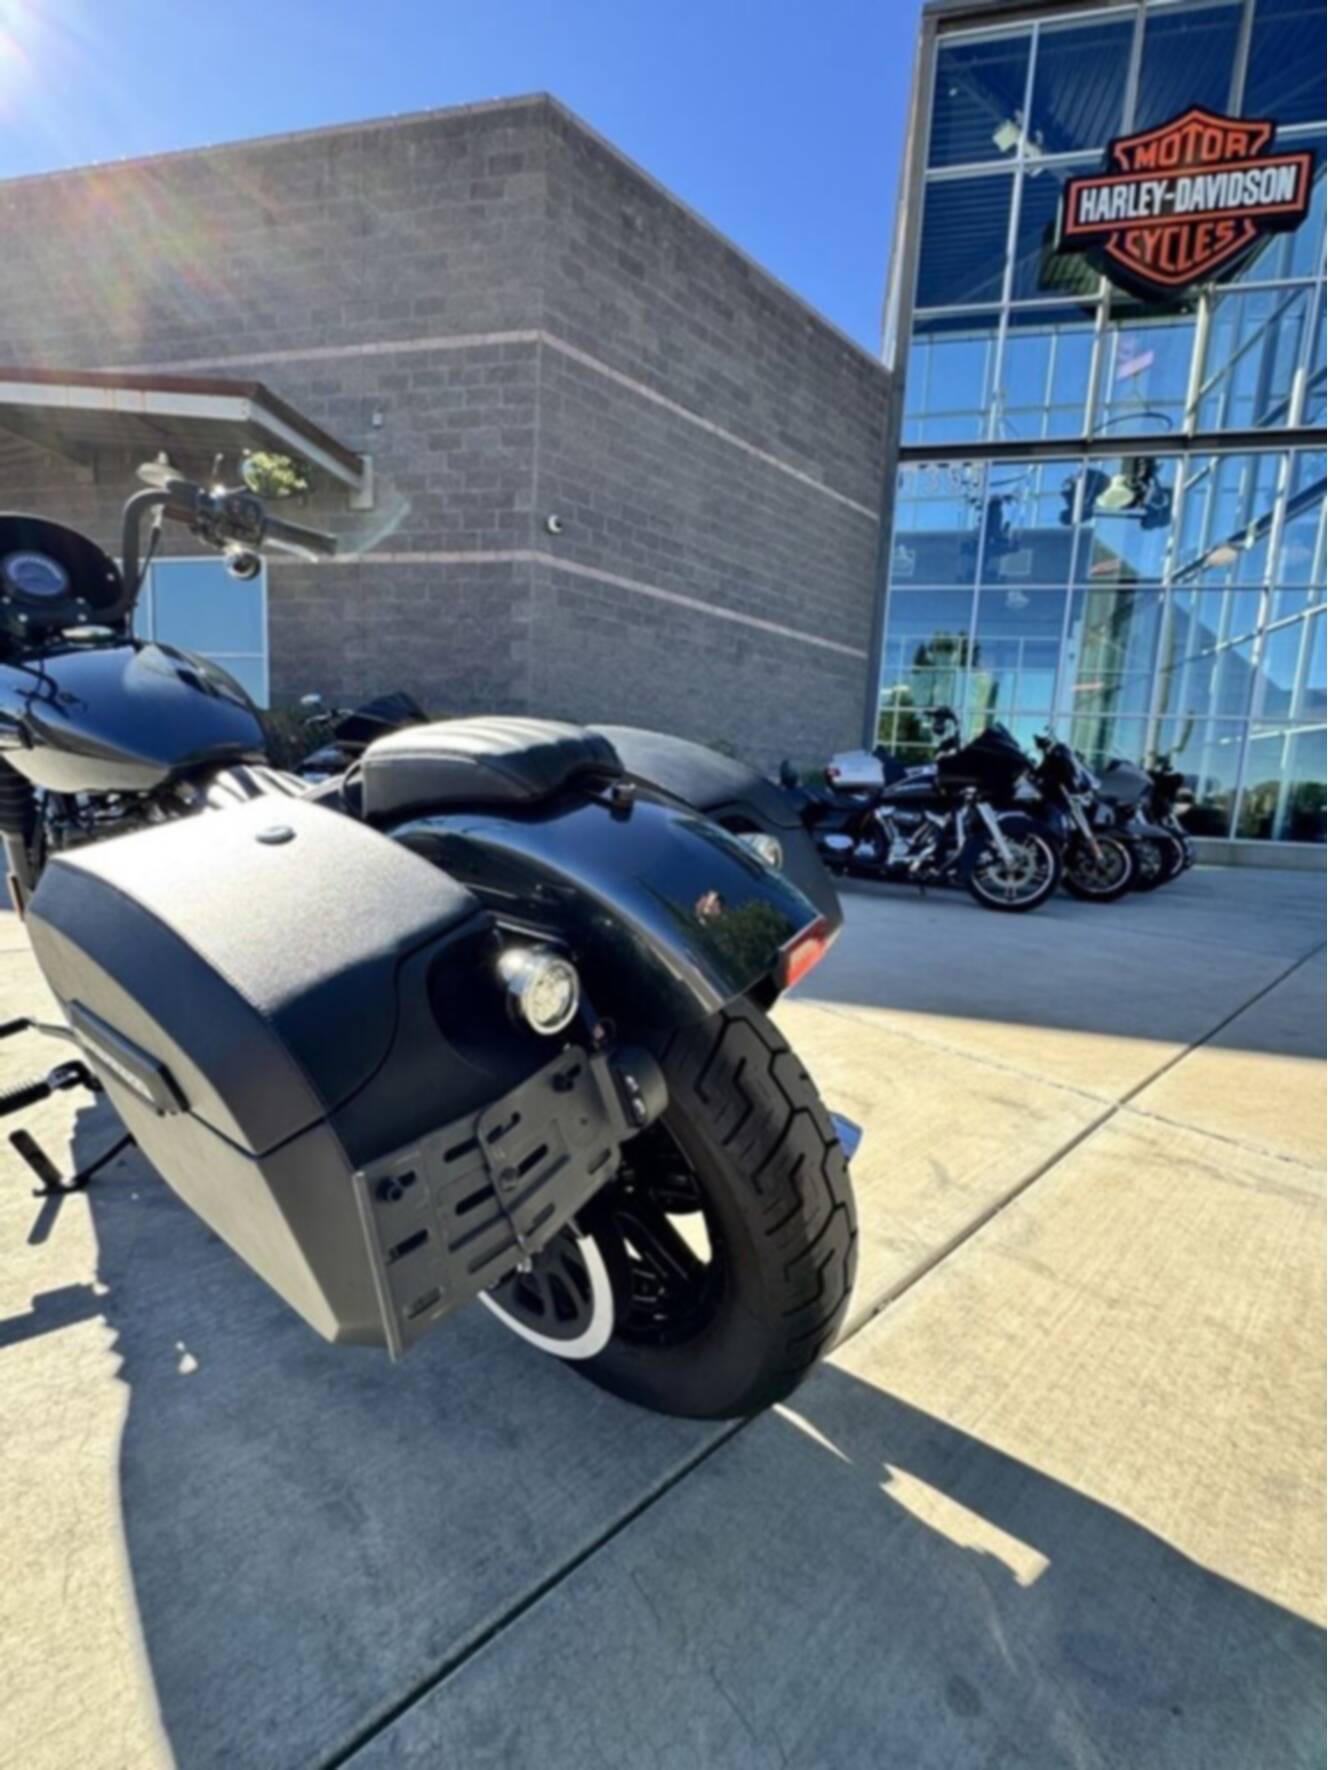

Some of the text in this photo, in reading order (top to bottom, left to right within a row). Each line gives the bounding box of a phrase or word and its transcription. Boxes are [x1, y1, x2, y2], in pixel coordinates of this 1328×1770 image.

[1133, 124, 1248, 170] MOTOR
[1078, 165, 1298, 223] HARLEY-DAVIDSON
[1125, 219, 1235, 272] CYCLES
